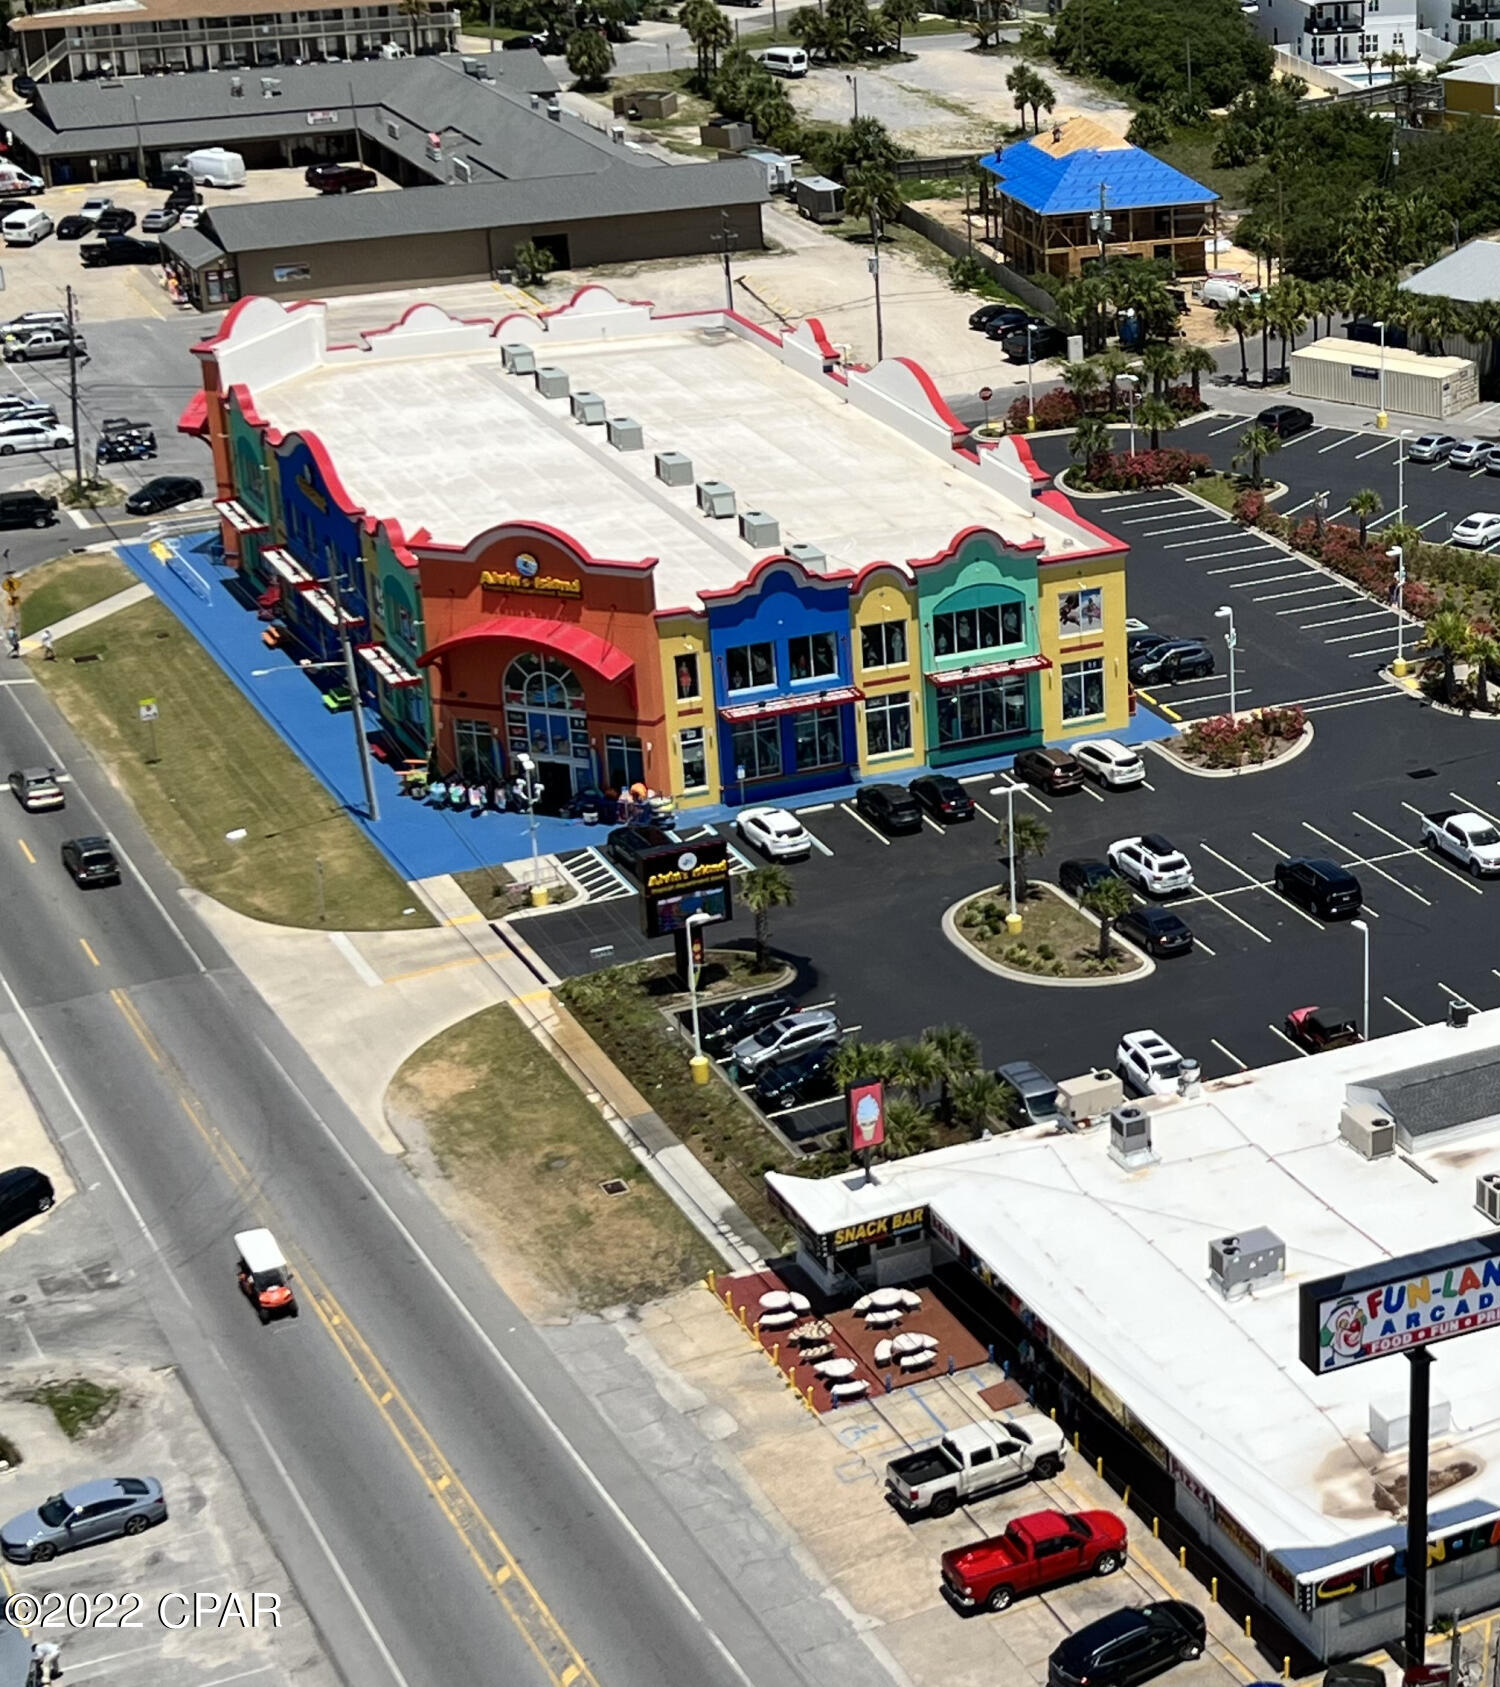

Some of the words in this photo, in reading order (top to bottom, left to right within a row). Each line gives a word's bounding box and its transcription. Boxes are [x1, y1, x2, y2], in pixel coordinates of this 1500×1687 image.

[834, 1217, 888, 1245] SNACK
[893, 1208, 924, 1229] BAR
[1371, 1332, 1413, 1354] FOOD
[1430, 1319, 1459, 1338] FUN
